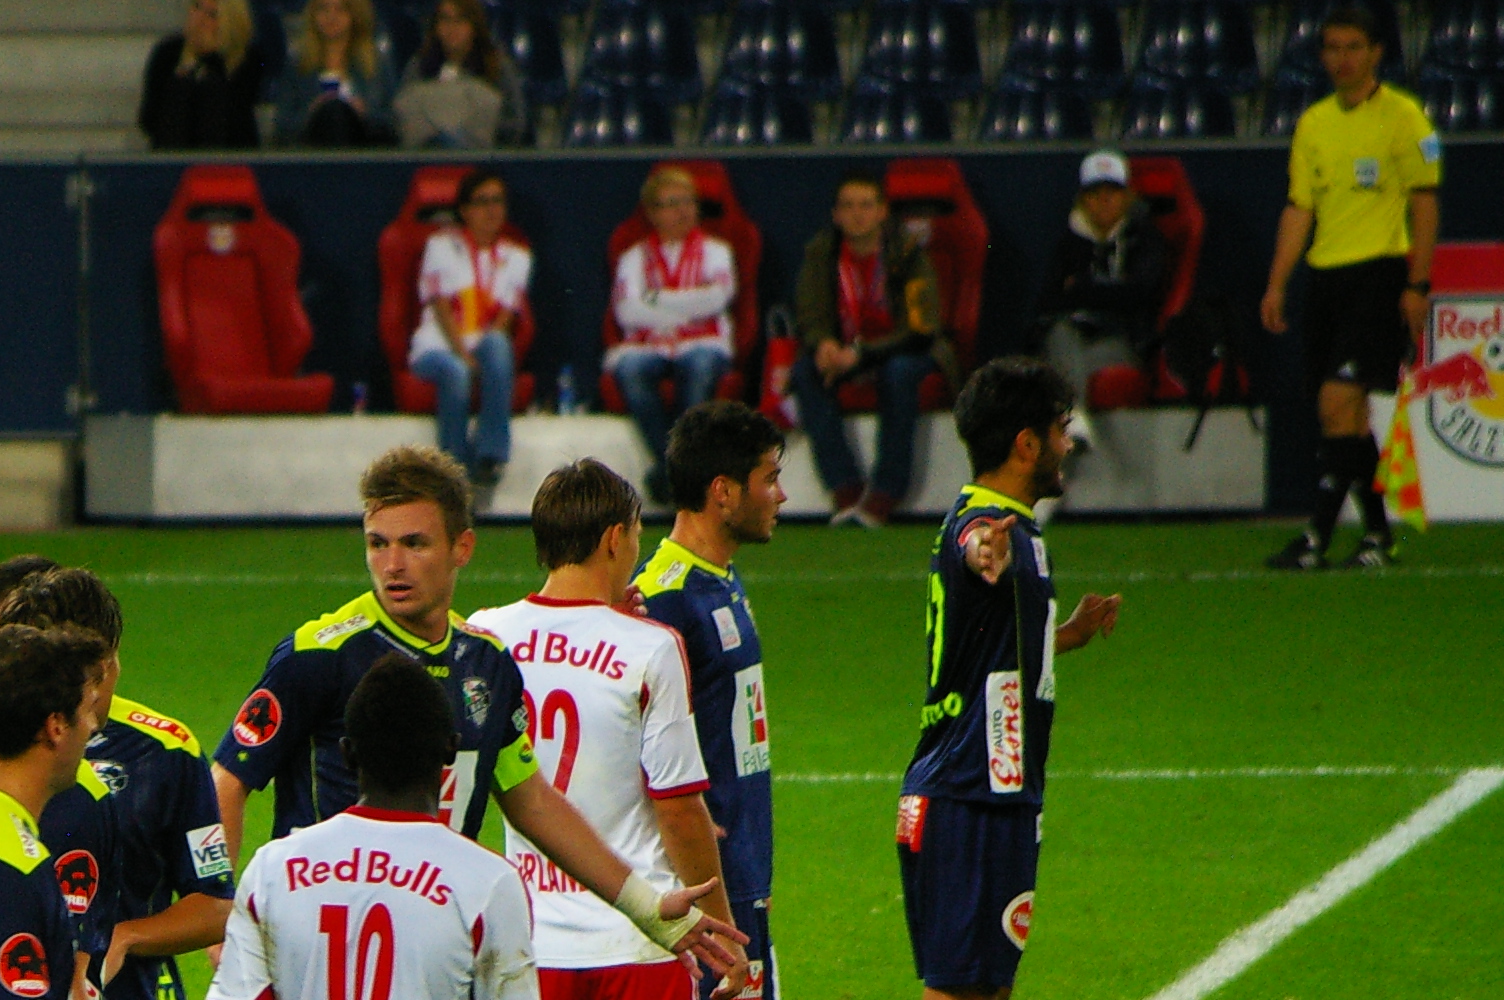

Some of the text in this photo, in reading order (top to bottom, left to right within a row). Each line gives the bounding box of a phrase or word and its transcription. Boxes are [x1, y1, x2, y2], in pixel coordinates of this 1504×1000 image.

[543, 632, 628, 680] Bulls
[286, 848, 453, 906] Red Bulls
